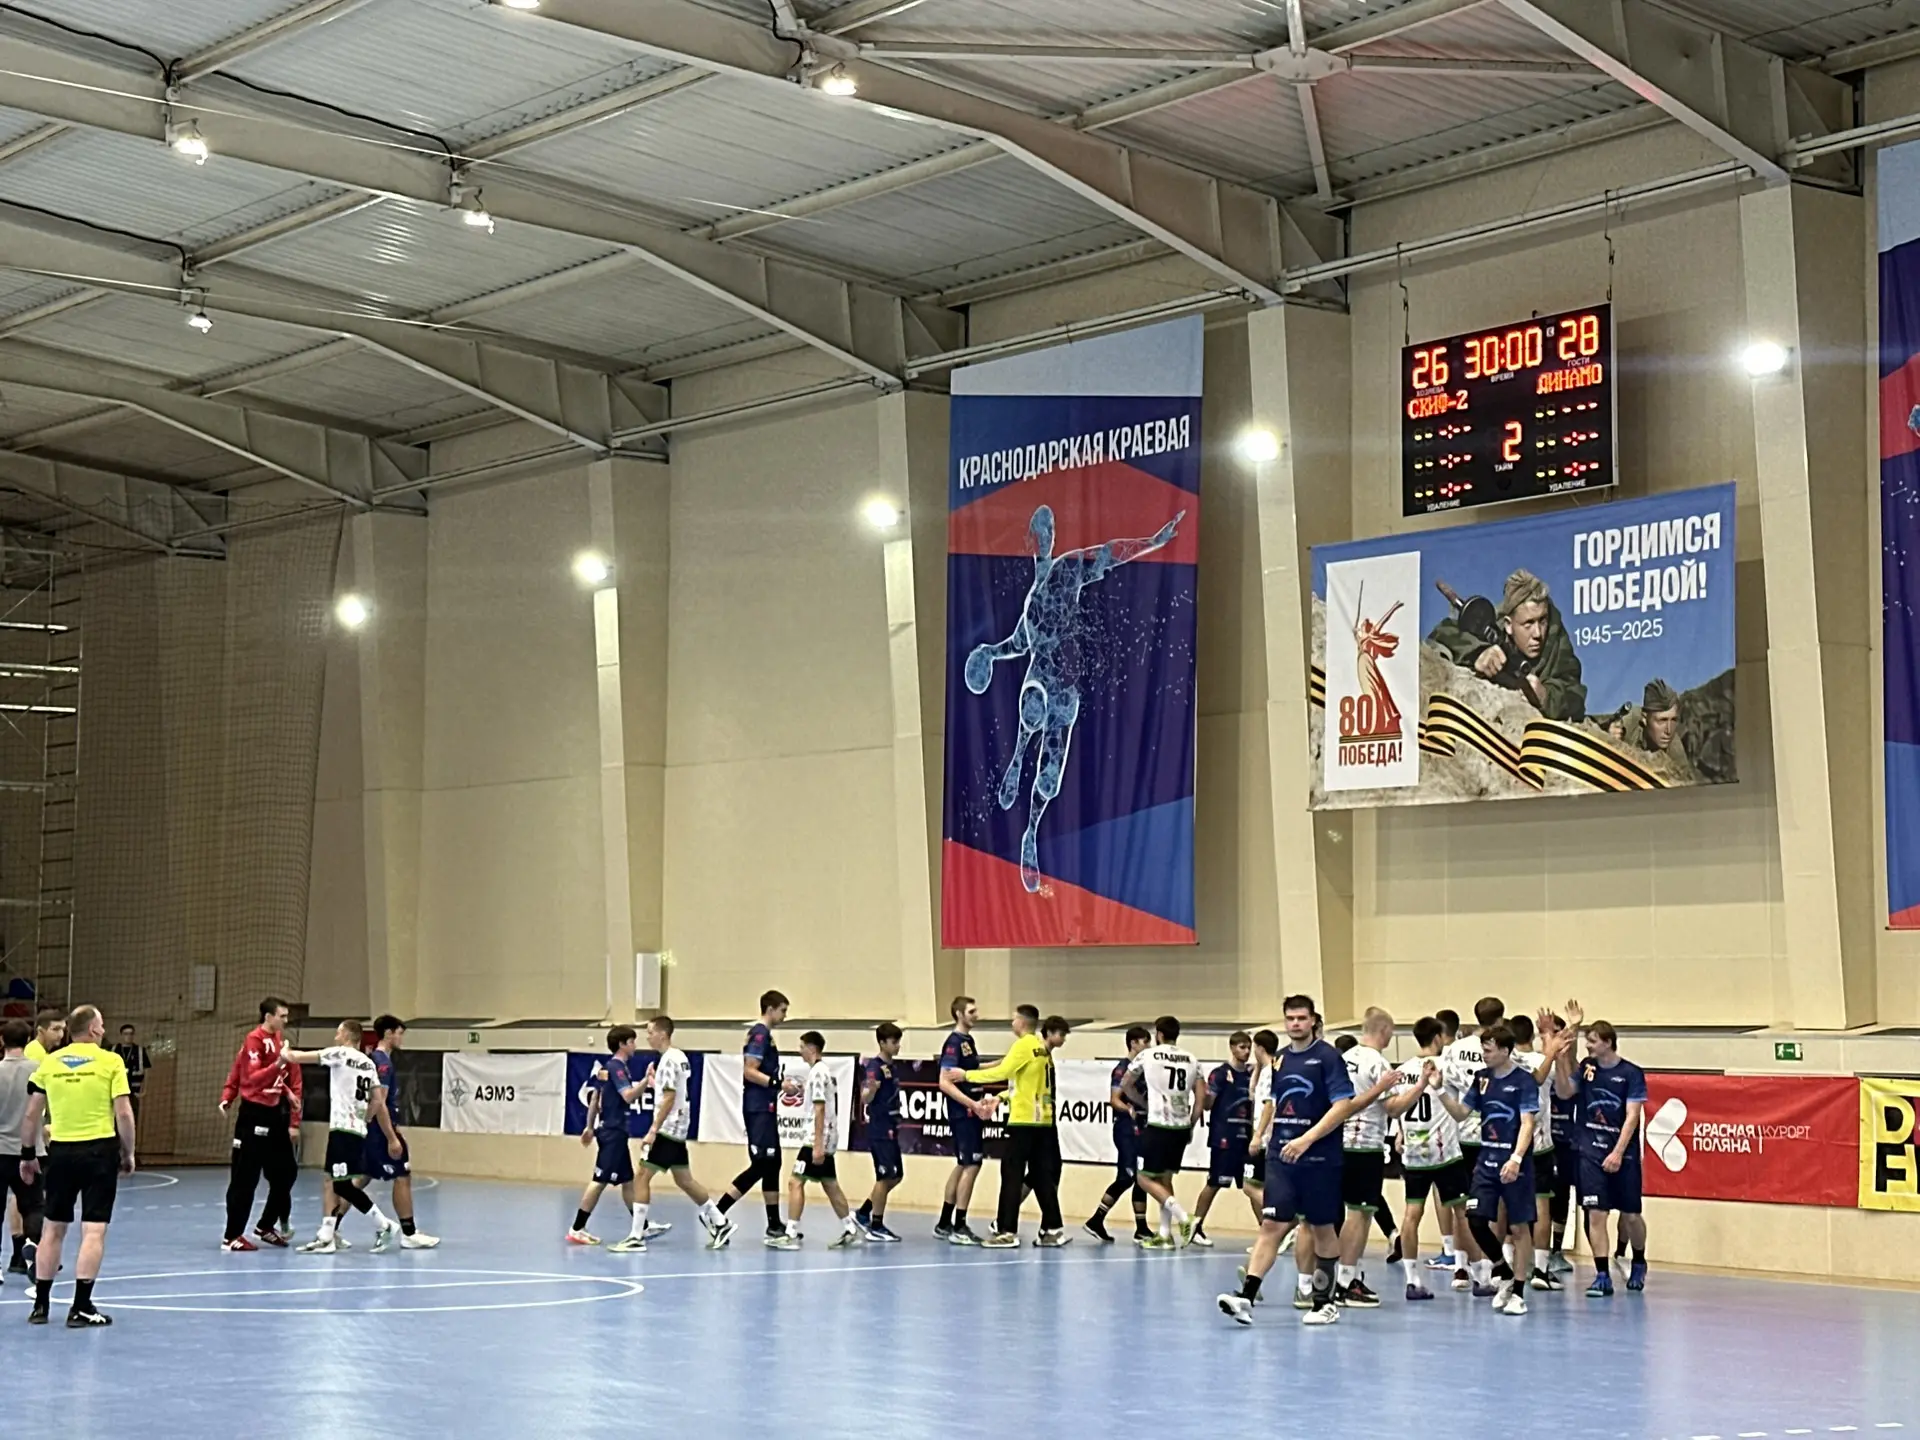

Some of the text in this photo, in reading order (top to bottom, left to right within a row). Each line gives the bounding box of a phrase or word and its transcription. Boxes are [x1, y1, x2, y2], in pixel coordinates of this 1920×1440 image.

[1559, 315, 1599, 360] 28
[1464, 326, 1543, 379] 30:00
[1567, 356, 1590, 367] ГОСТИ
[1412, 346, 1449, 389] 26
[1536, 362, 1603, 395] ДИНАМО
[1407, 389, 1469, 420] СКИФ-2
[959, 414, 1190, 489] КРАСНОДАРСКАЯ КРАЕВАЯ
[1503, 420, 1522, 462] 2
[1494, 462, 1514, 472] ТАЙМ
[1549, 479, 1587, 492] УДАЛЕНИЕ
[1427, 499, 1461, 512] УДАЛЕНИЕ
[1573, 512, 1721, 569] ГОРДИМСЯ
[1573, 558, 1707, 615] ПОБЕДОЙ!
[1574, 618, 1663, 646] 1945–2025
[1339, 694, 1374, 736] 80
[1338, 741, 1402, 767] ПОБЕДА!
[1163, 1065, 1187, 1092] 78
[474, 1085, 515, 1102] АЭМЗ
[1692, 1122, 1756, 1139] КРАСНАЯ
[1763, 1125, 1811, 1140] КУРОРТ
[1692, 1137, 1752, 1154] ПОЛЯНА
